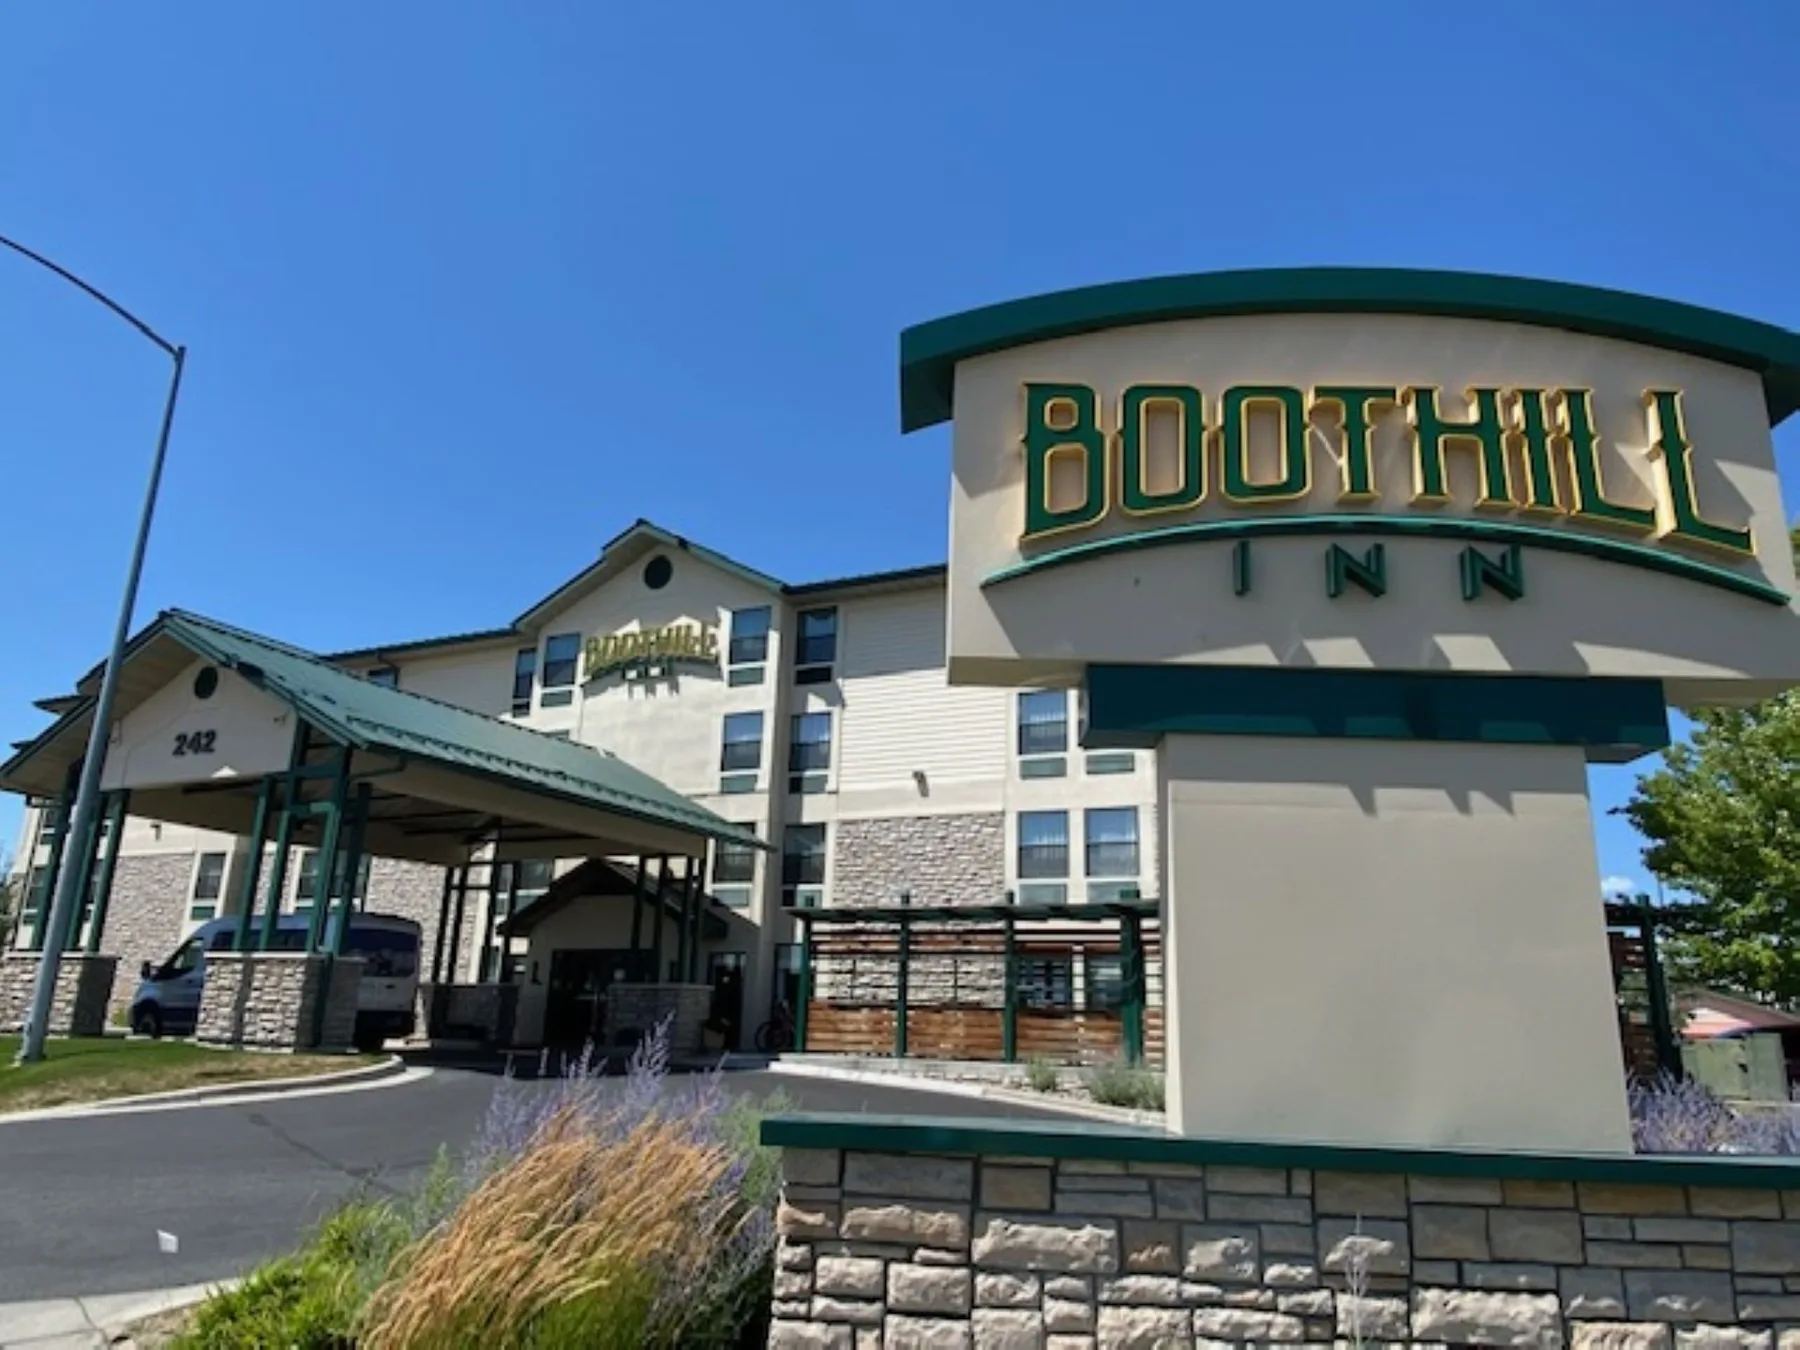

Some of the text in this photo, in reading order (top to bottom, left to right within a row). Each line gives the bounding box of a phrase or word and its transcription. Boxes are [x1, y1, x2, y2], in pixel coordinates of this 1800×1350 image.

[1020, 383, 1755, 557] BOOTHILL
[1232, 540, 1525, 600] INN
[172, 729, 217, 756] 242
